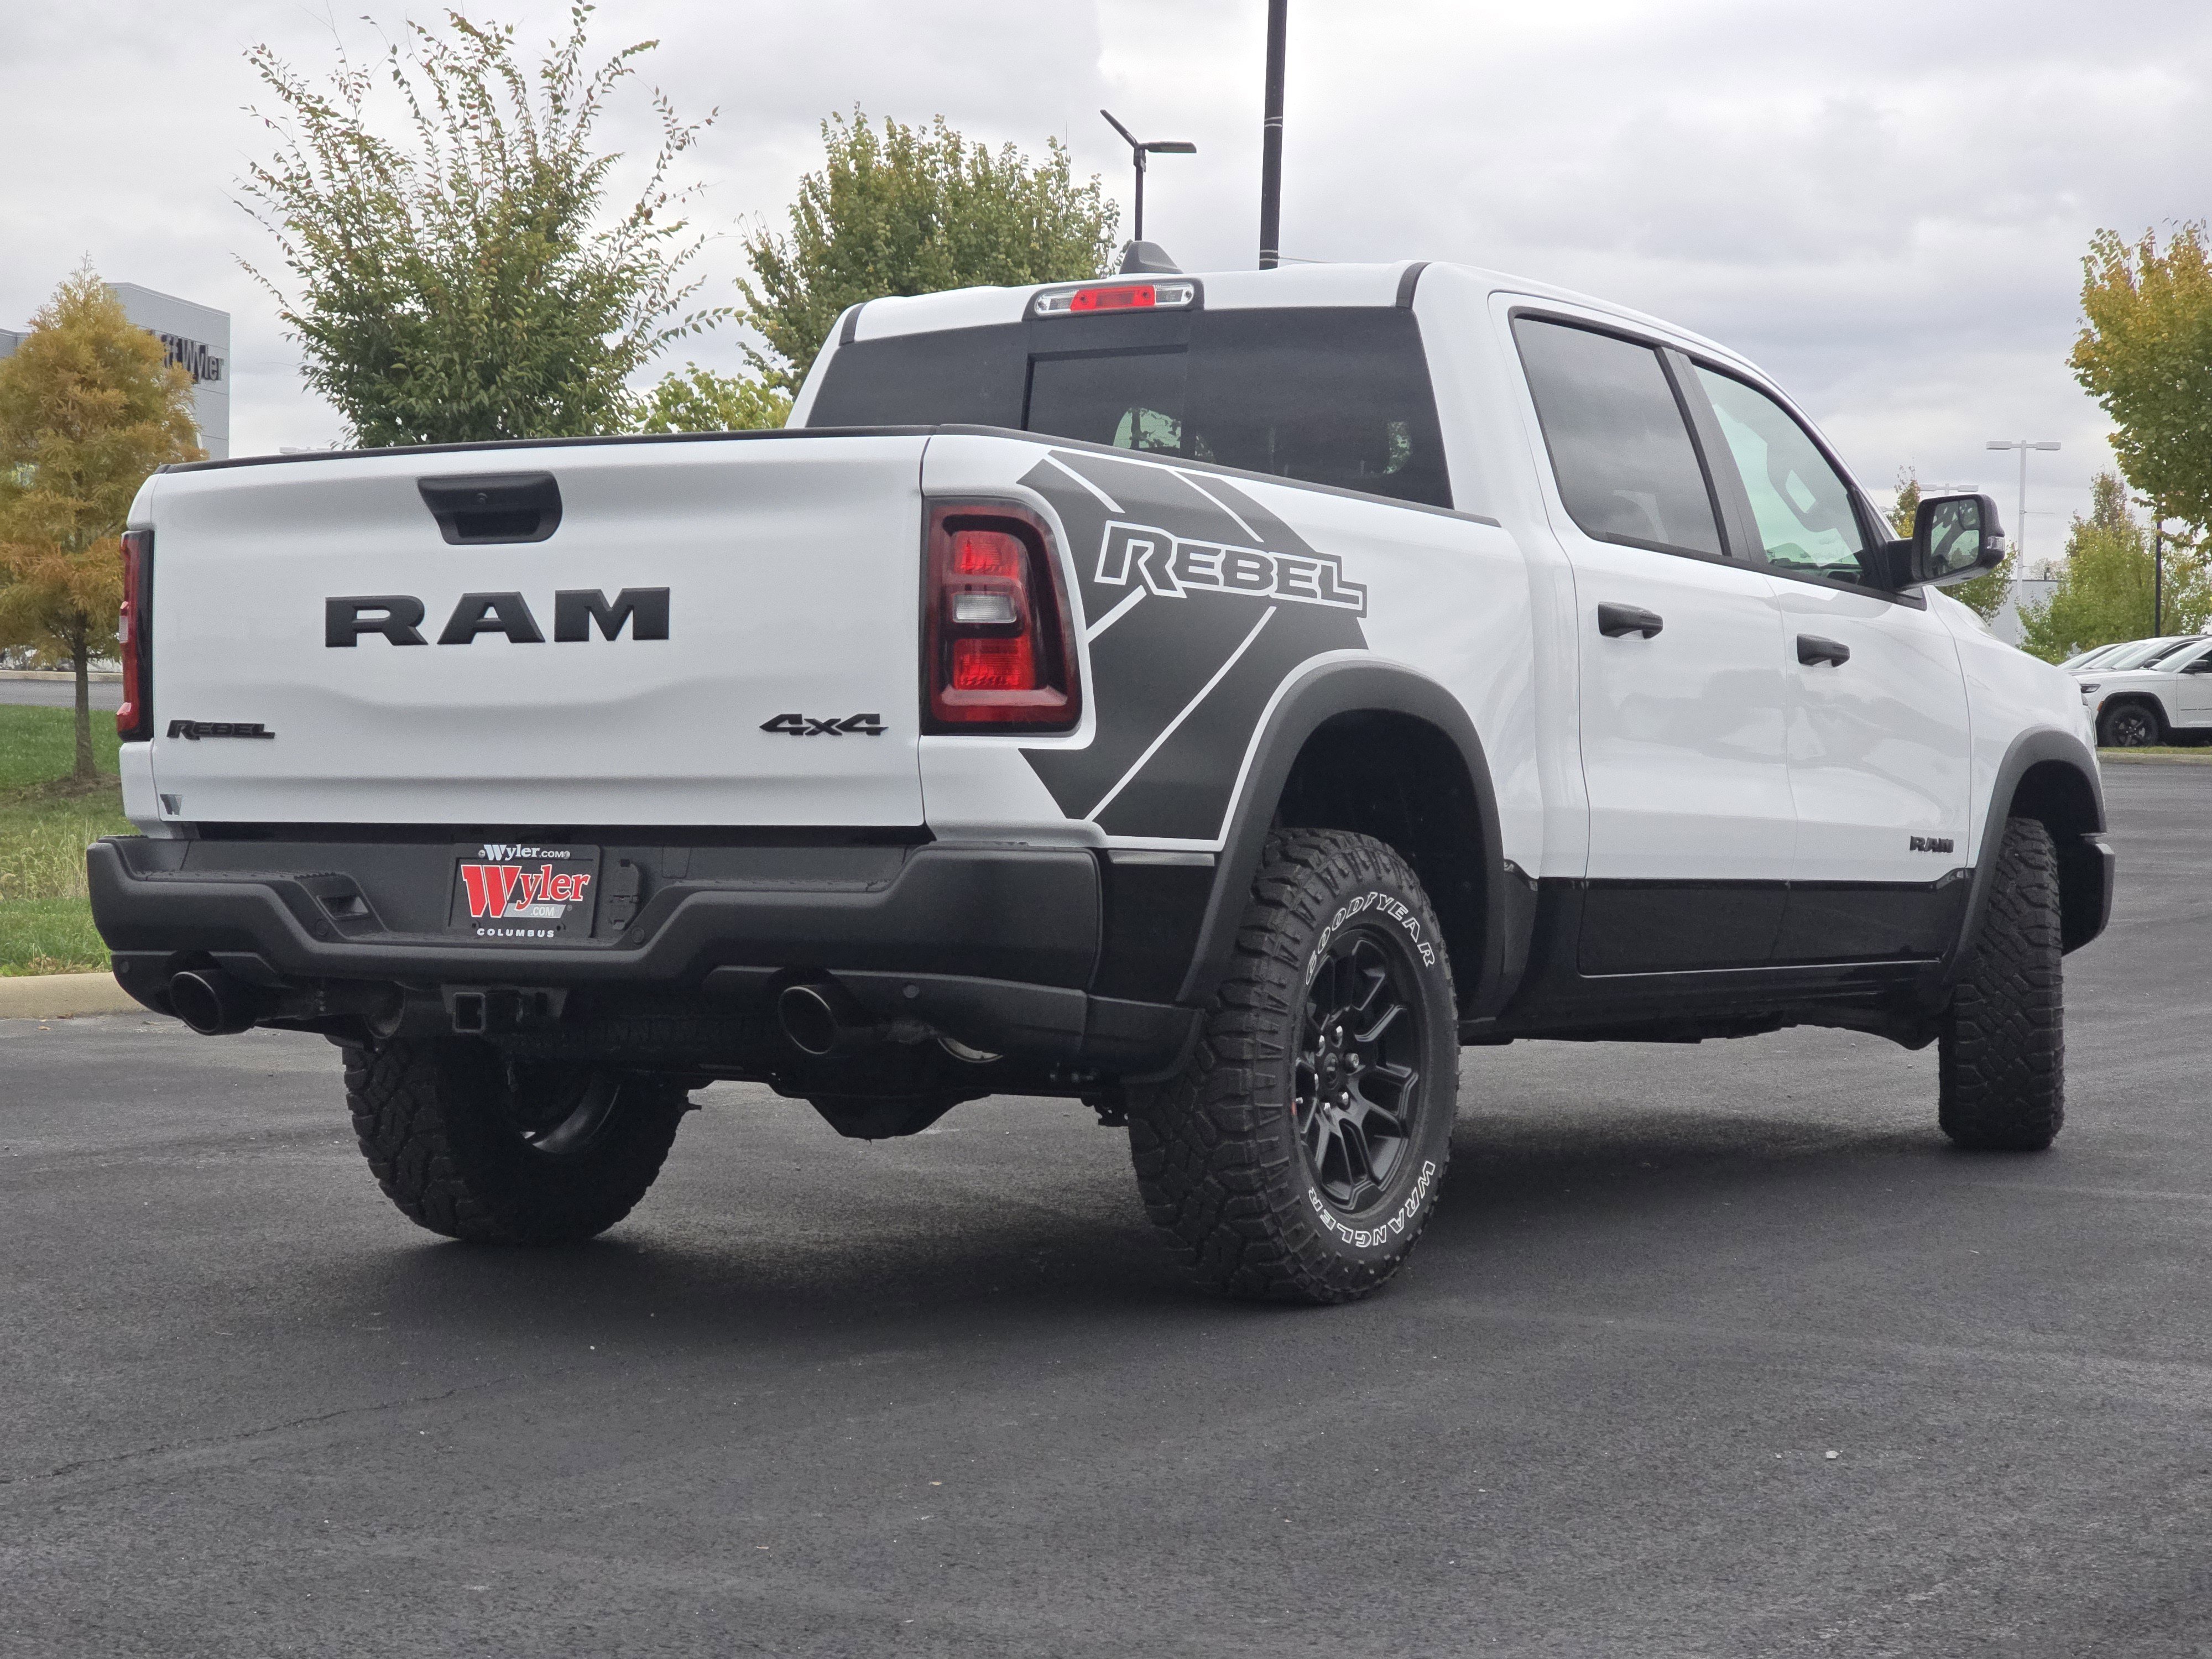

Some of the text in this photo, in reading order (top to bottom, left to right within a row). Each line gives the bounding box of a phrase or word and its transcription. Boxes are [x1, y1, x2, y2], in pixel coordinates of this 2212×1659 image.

[181, 338, 224, 383] Wyler
[1094, 520, 1363, 611] REBEL
[325, 587, 670, 648] RAM
[166, 719, 275, 740] REBEL
[1910, 836, 1954, 853] RAM
[461, 864, 591, 919] Wyler
[477, 928, 555, 938] COLUMBUS
[1306, 891, 1435, 985] GOODYEAR
[1308, 1160, 1436, 1248] WRANGLER
